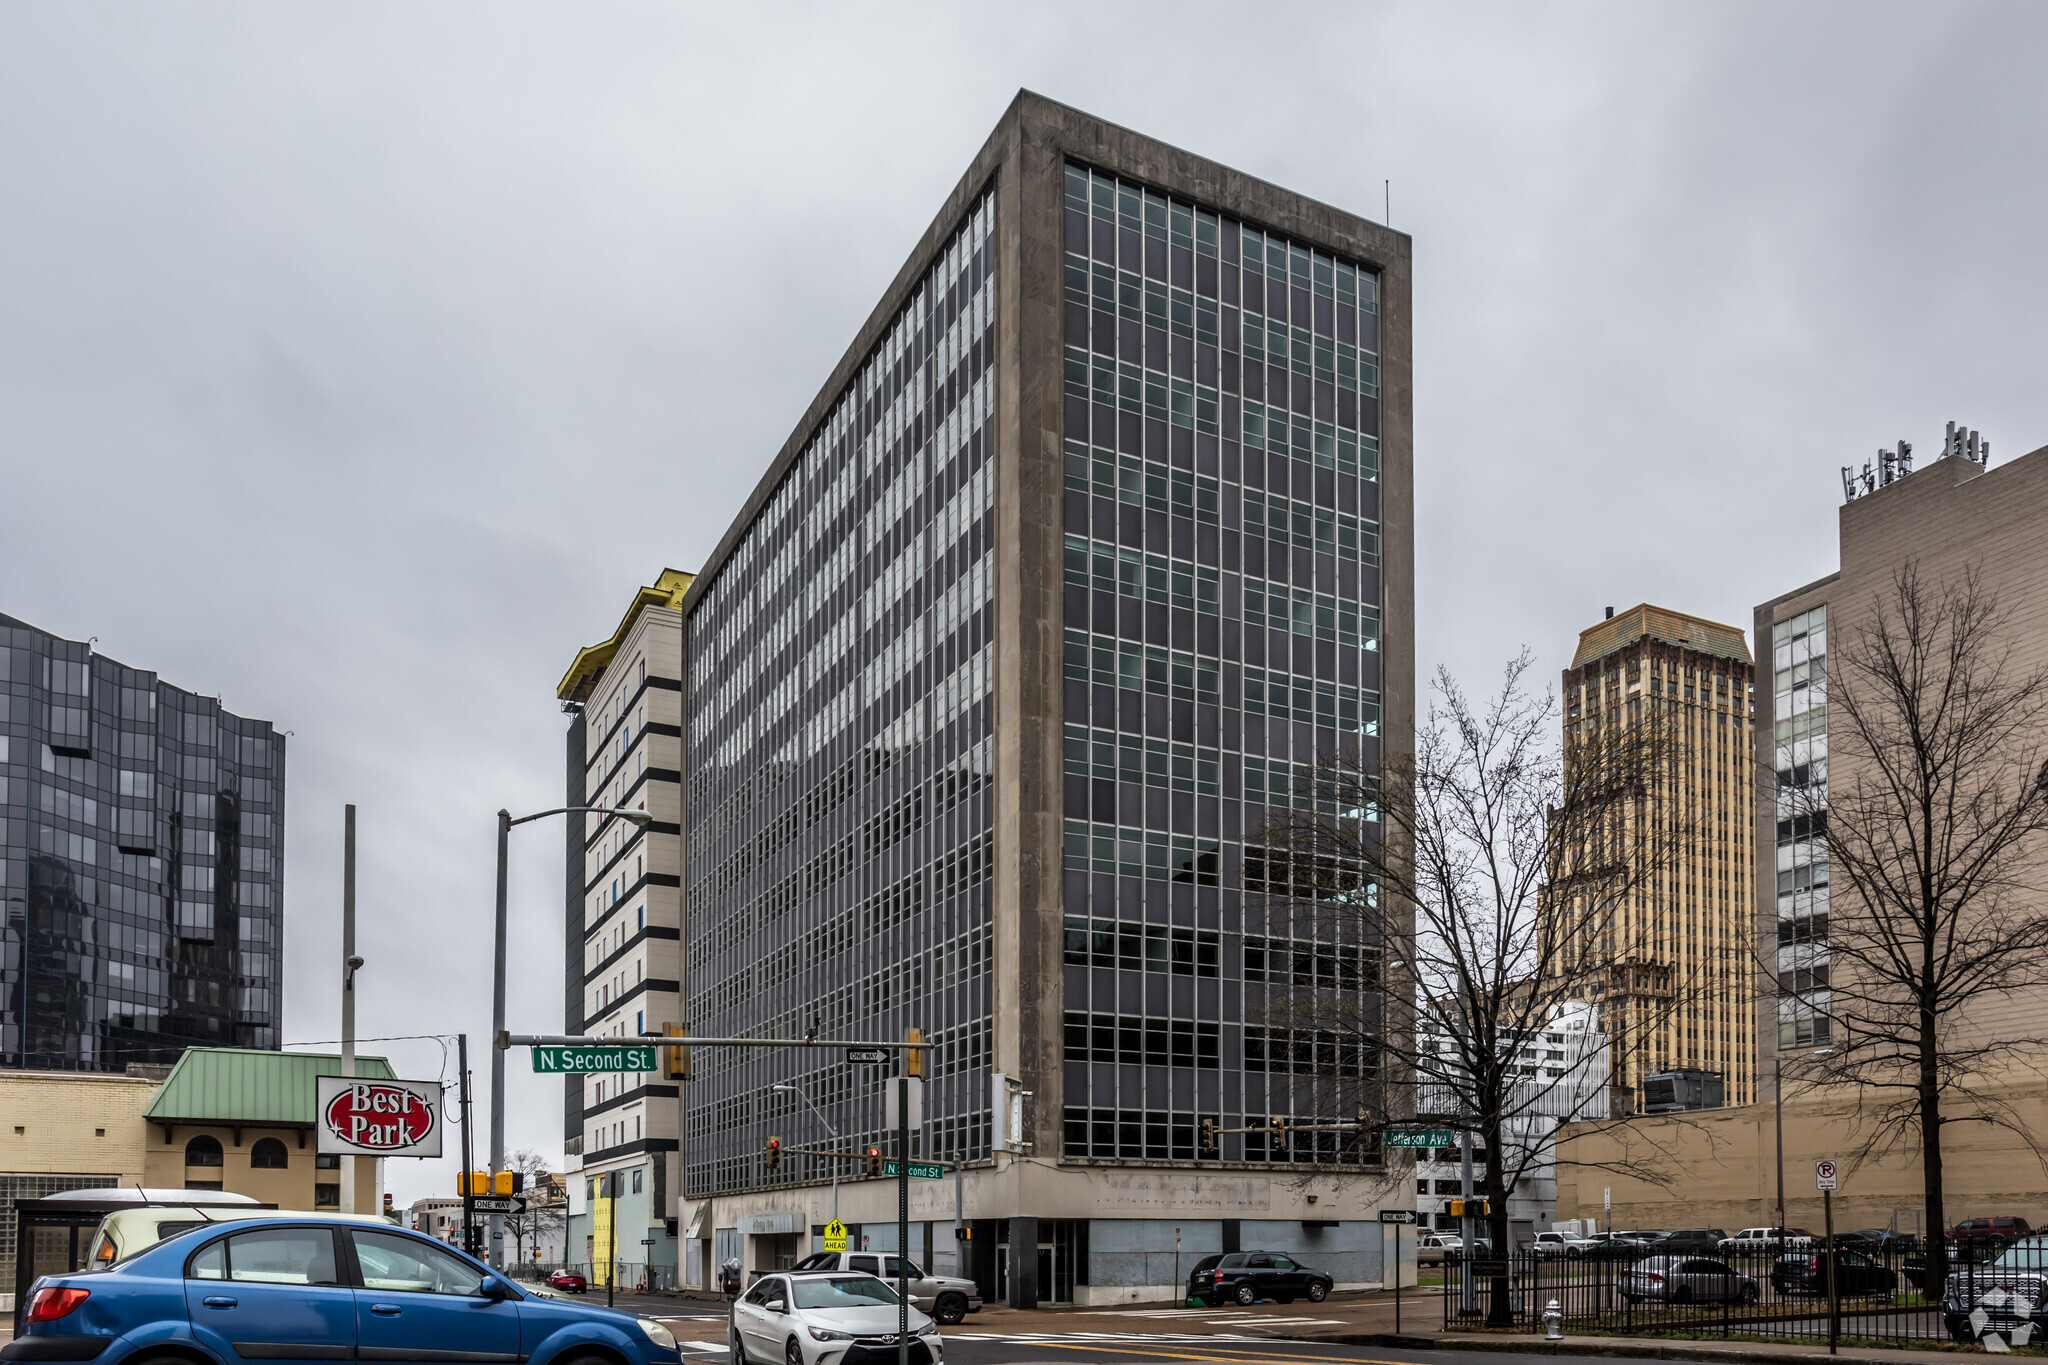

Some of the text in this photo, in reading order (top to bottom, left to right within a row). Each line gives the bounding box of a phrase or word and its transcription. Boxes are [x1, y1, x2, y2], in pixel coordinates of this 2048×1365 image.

[541, 1051, 651, 1070] N. Second St.
[349, 1083, 414, 1114] Best
[349, 1115, 417, 1146] Park
[1387, 1132, 1426, 1145] Jefferson
[898, 1166, 927, 1177] cond
[476, 1200, 511, 1209] ONE WAY
[824, 1242, 846, 1250] AHEAD
